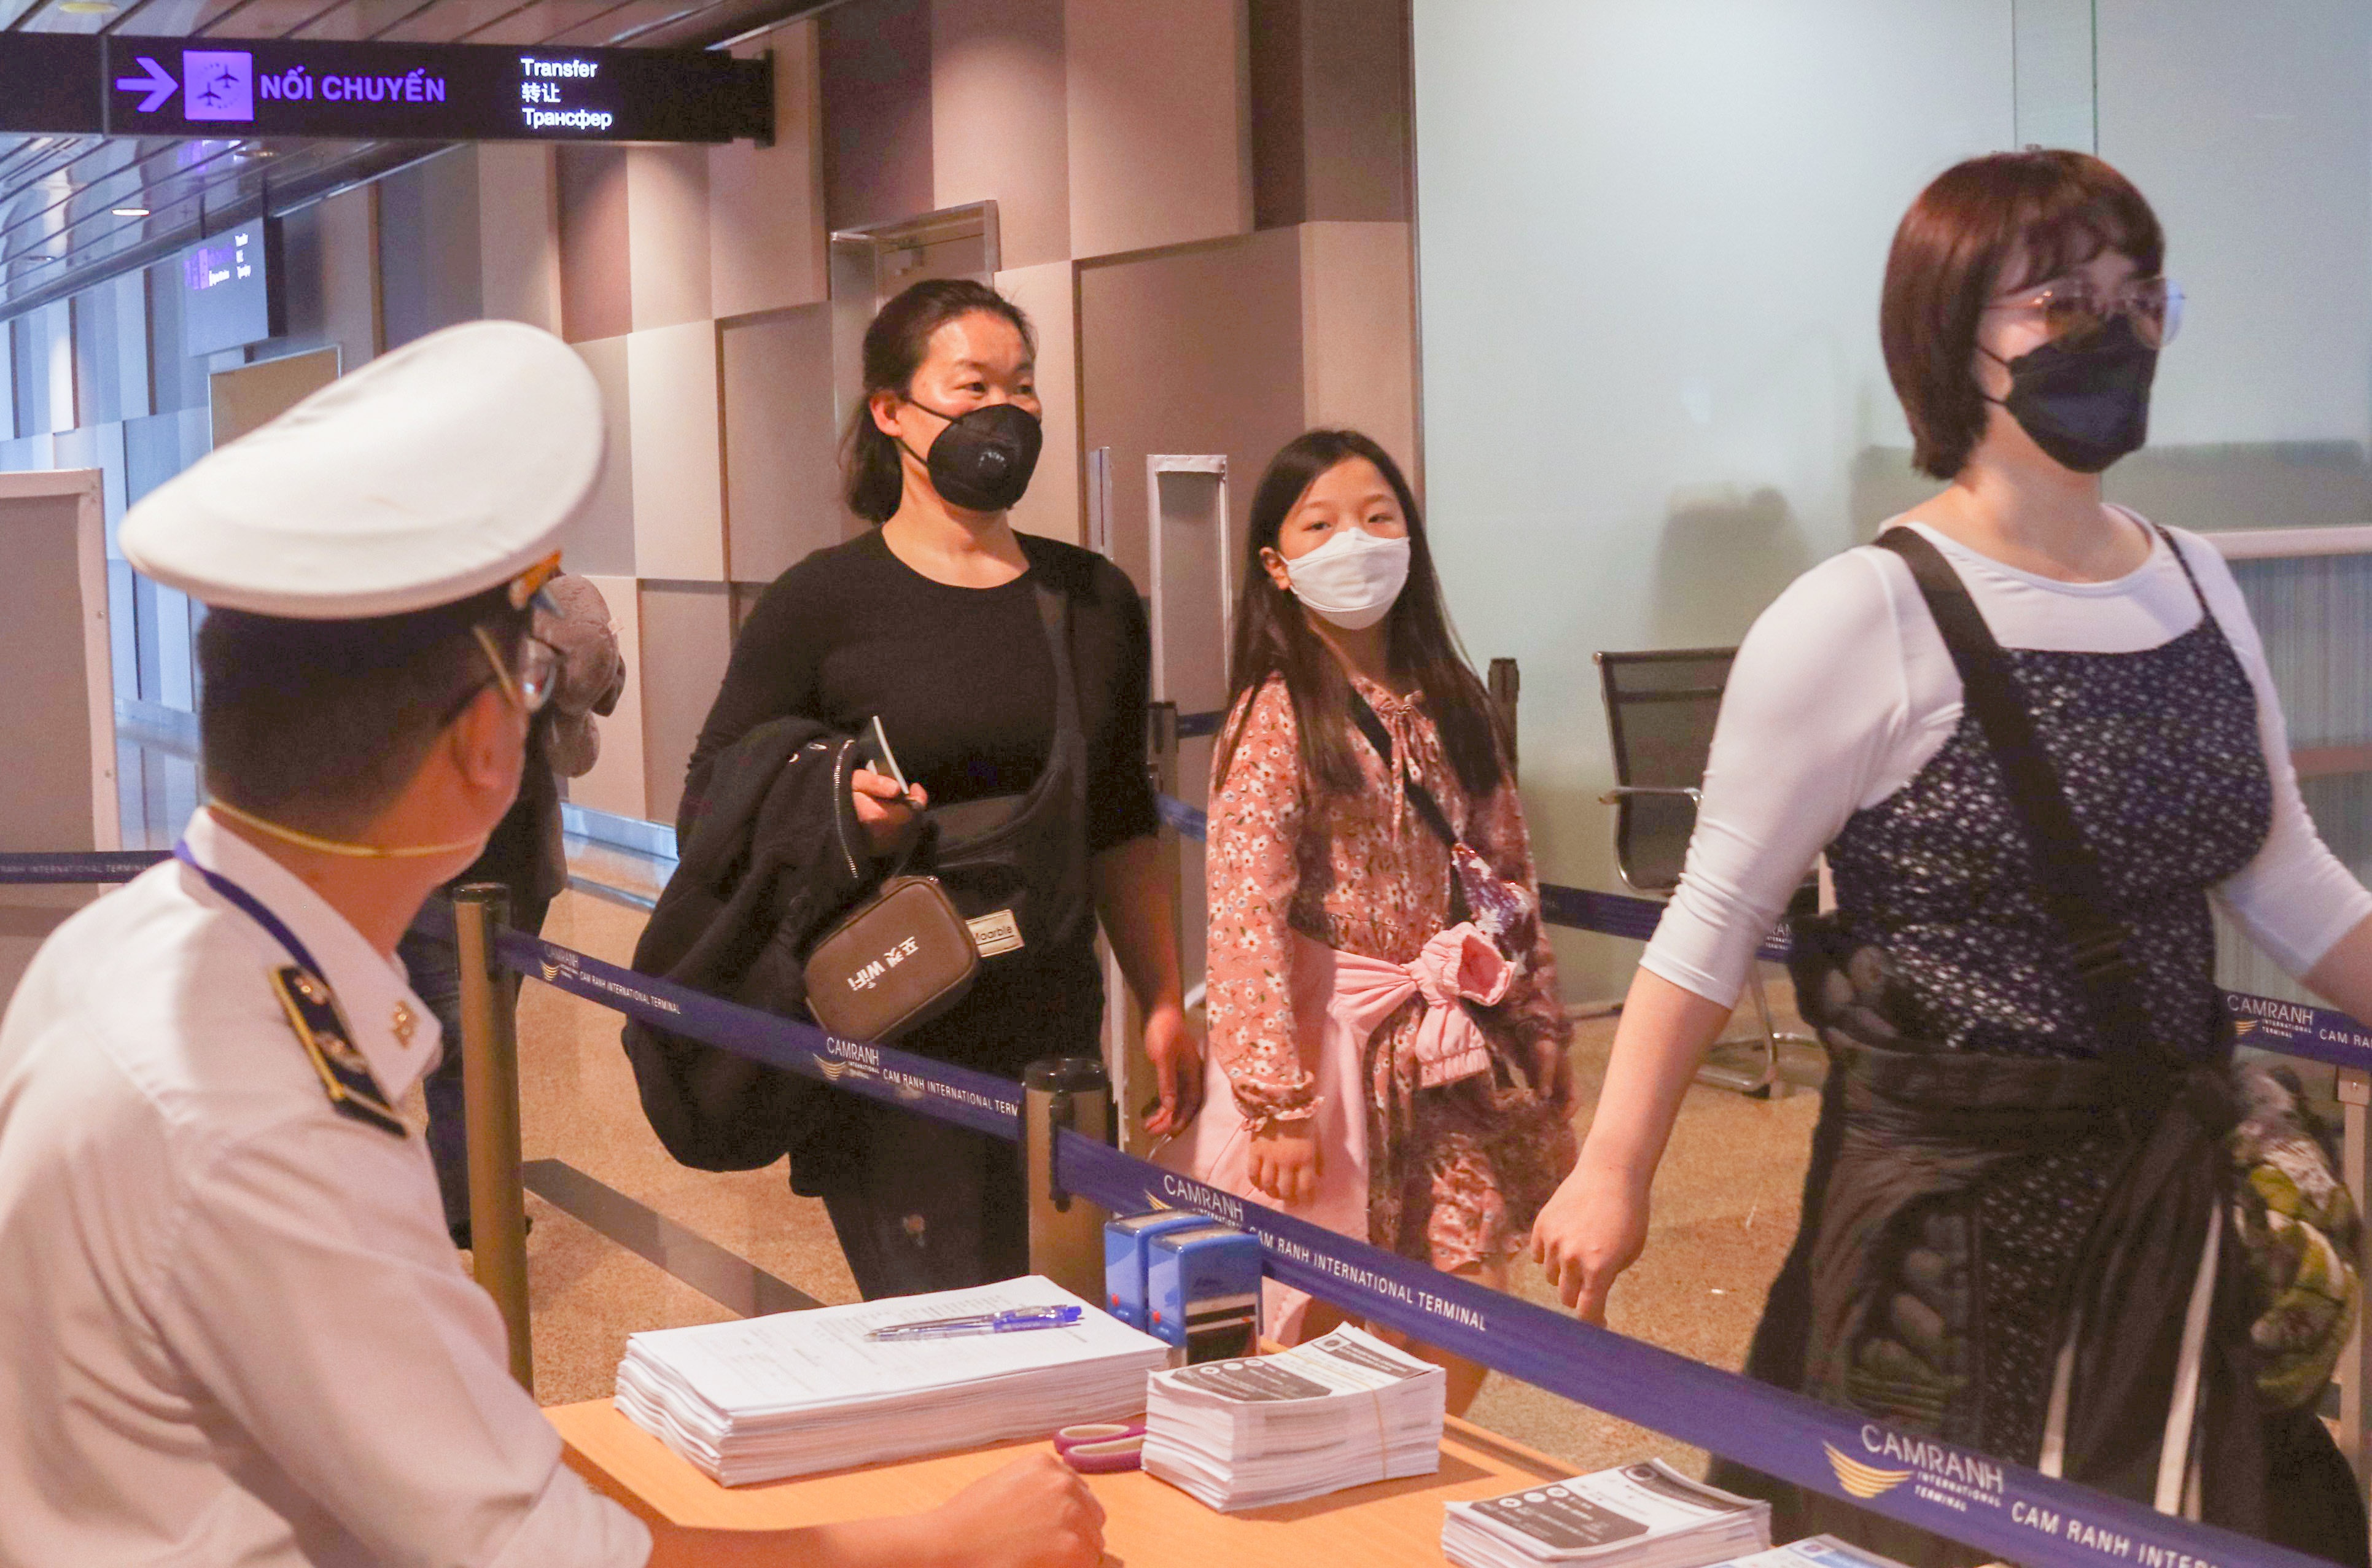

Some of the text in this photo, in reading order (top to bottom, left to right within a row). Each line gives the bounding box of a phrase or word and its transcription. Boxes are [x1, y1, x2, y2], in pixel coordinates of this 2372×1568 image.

[260, 64, 446, 101] NỐI CHUYẾN
[520, 58, 598, 78] Transfer
[521, 82, 561, 104] 转让
[521, 107, 613, 131] Трансфер
[607, 980, 650, 1004] INTERNATIONAL
[651, 996, 681, 1014] TERMINAL
[2227, 995, 2314, 1026] CAMRANH
[2262, 1019, 2312, 1033] INTERNATIONAL
[2262, 1027, 2293, 1038] TERMINAL
[2319, 1028, 2372, 1049] CAM RA
[826, 1037, 879, 1066] CAMRANH
[883, 1068, 900, 1084] CAM
[903, 1074, 924, 1091] RANH
[927, 1080, 992, 1110] INTERNATIONAL
[1164, 1174, 1244, 1222] CAMRANH
[1278, 1238, 1310, 1262] RANH
[1313, 1252, 1413, 1304] INTERNATIONAL
[1417, 1291, 1486, 1332] TERMINAL
[1861, 1424, 2004, 1494] CAMRANH
[1915, 1484, 1967, 1512] TERMINAL
[1917, 1471, 2001, 1508] INTERNATIONAL
[2011, 1500, 2060, 1535] CAM
[2066, 1519, 2131, 1558] RANH
